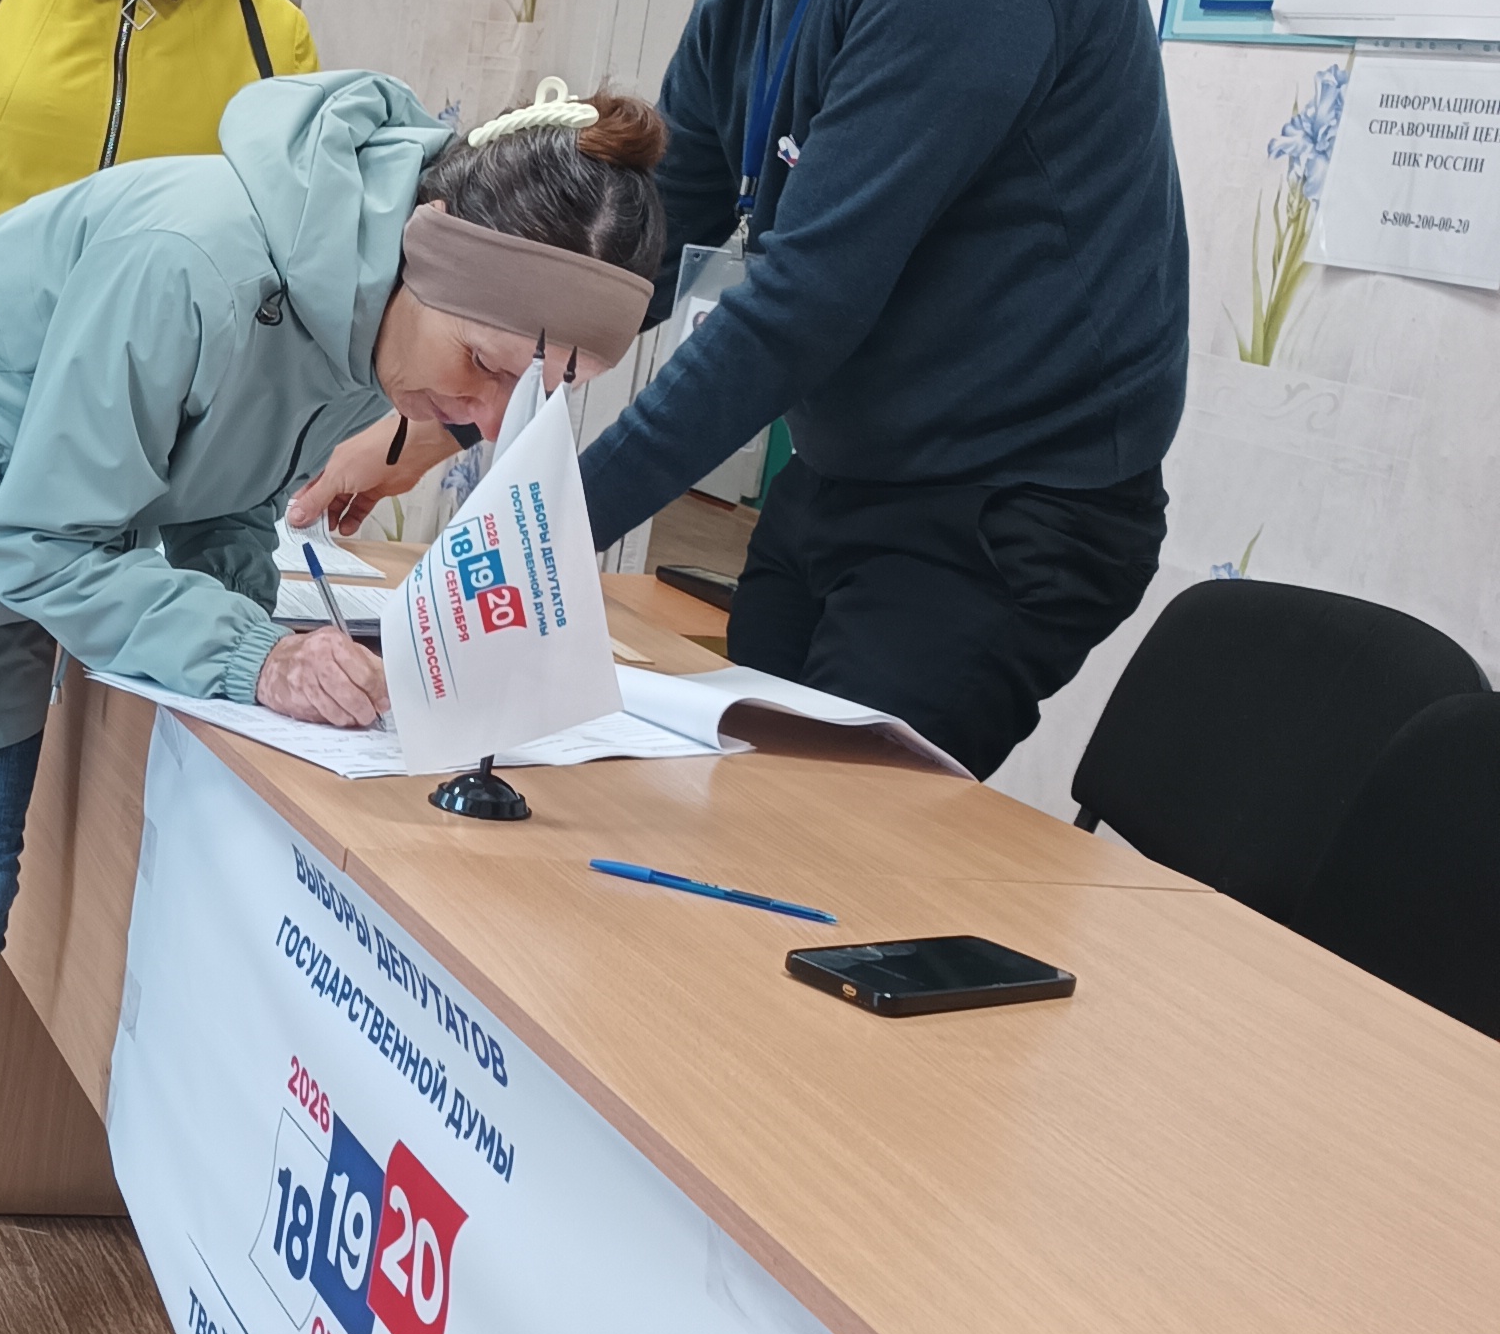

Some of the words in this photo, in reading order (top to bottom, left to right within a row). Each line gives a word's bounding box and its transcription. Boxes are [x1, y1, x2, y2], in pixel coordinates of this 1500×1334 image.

[1368, 119, 1470, 141] СПРАВОЧНЫЙ
[1392, 151, 1423, 168] ЦИК
[1424, 154, 1485, 173] РОССИИ
[1380, 210, 1470, 234] 8-800-200-00-20
[483, 513, 499, 547] 2026
[509, 484, 543, 599] ГОСУДАРСТВЕННОЙ
[533, 602, 549, 636] ДУМЫ
[529, 482, 550, 544] ВЫБОРЫ
[541, 546, 566, 628] ДЕПУТАТОВ
[445, 570, 470, 643] СЕНТЯБРЯ
[450, 526, 474, 558] 18
[467, 556, 495, 588] 19
[486, 588, 515, 627] 20
[416, 596, 431, 635] СИЛА
[423, 637, 446, 699] РОССИИ!
[292, 843, 372, 954] ВЫБОРЫ
[373, 924, 508, 1087] ДЕПУТАТОВ
[276, 915, 448, 1113] ГОСУДАРСТВЕННОЙ
[445, 1087, 514, 1183] ДУМЫ
[288, 1055, 330, 1133] 2026
[273, 1167, 313, 1280] 18
[327, 1171, 372, 1291] 19
[380, 1185, 444, 1324] 20
